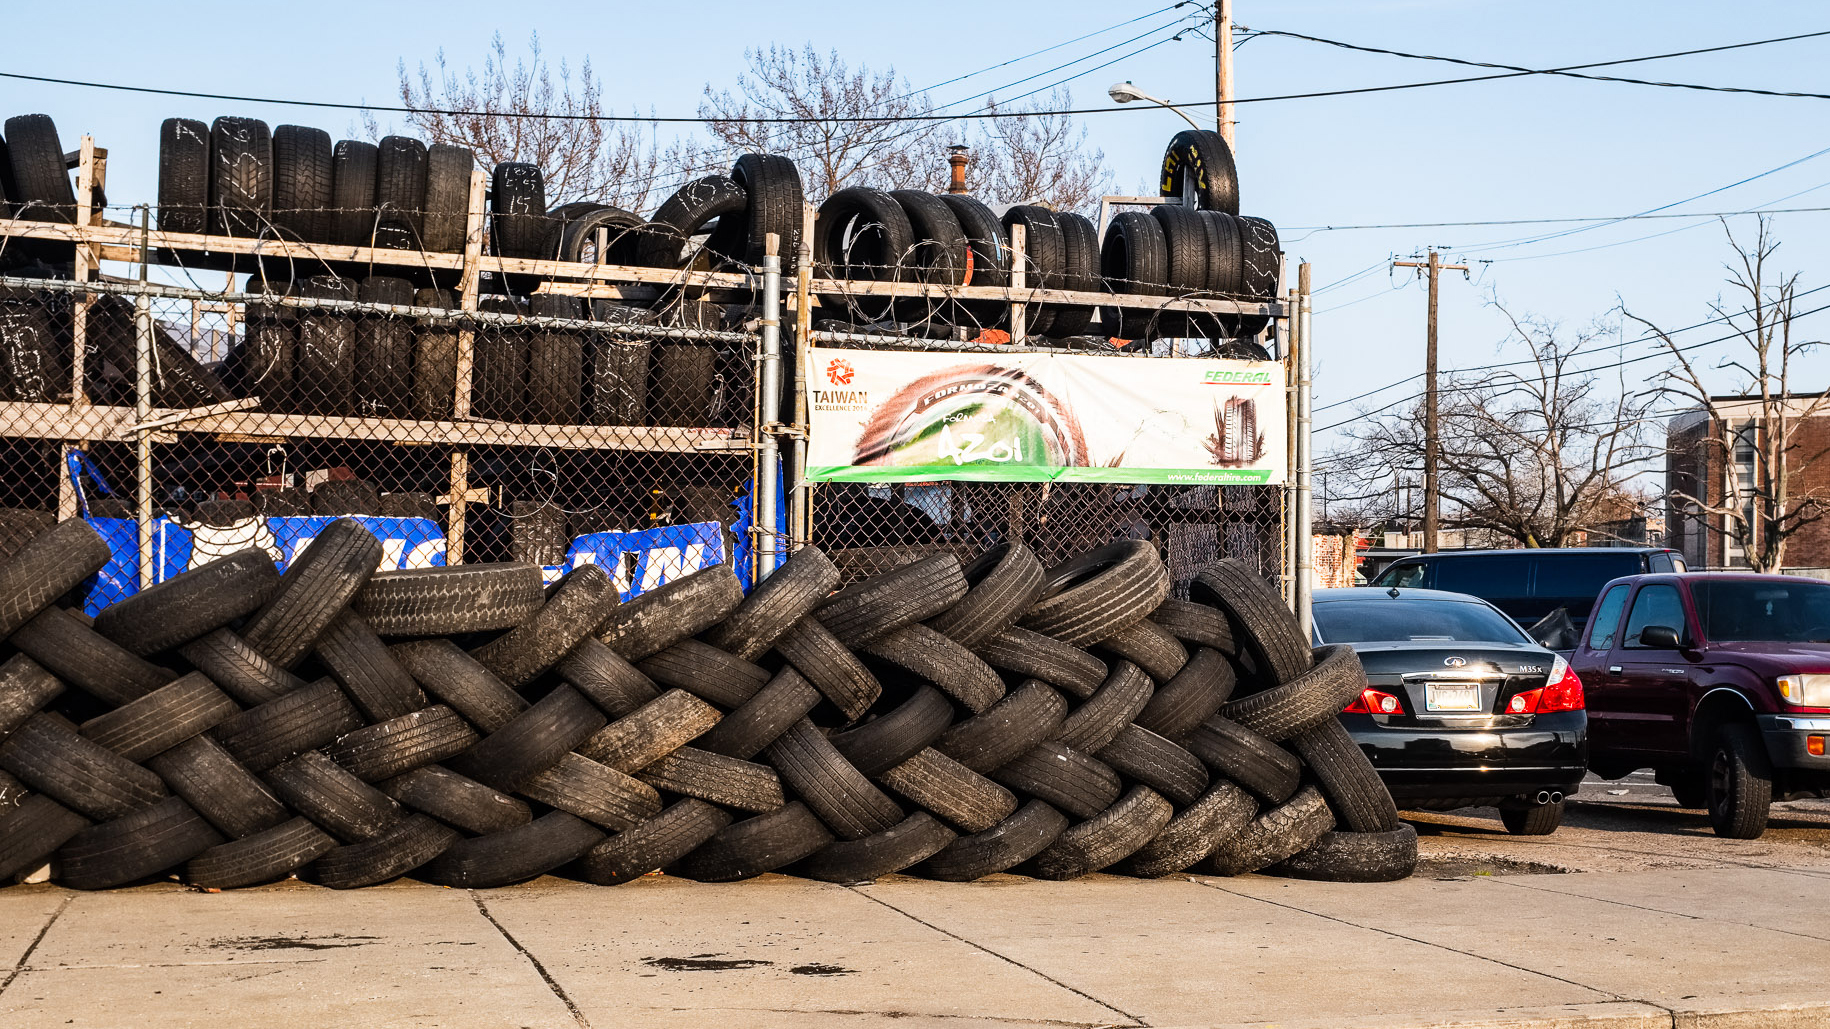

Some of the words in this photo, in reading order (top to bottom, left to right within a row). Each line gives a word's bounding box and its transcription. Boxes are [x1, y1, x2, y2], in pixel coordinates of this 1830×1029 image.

[1204, 370, 1271, 382] FEDERAL
[812, 390, 868, 404] TAIWAN
[924, 382, 1009, 406] FORMOZA
[1167, 472, 1262, 482] www.federaltire.com
